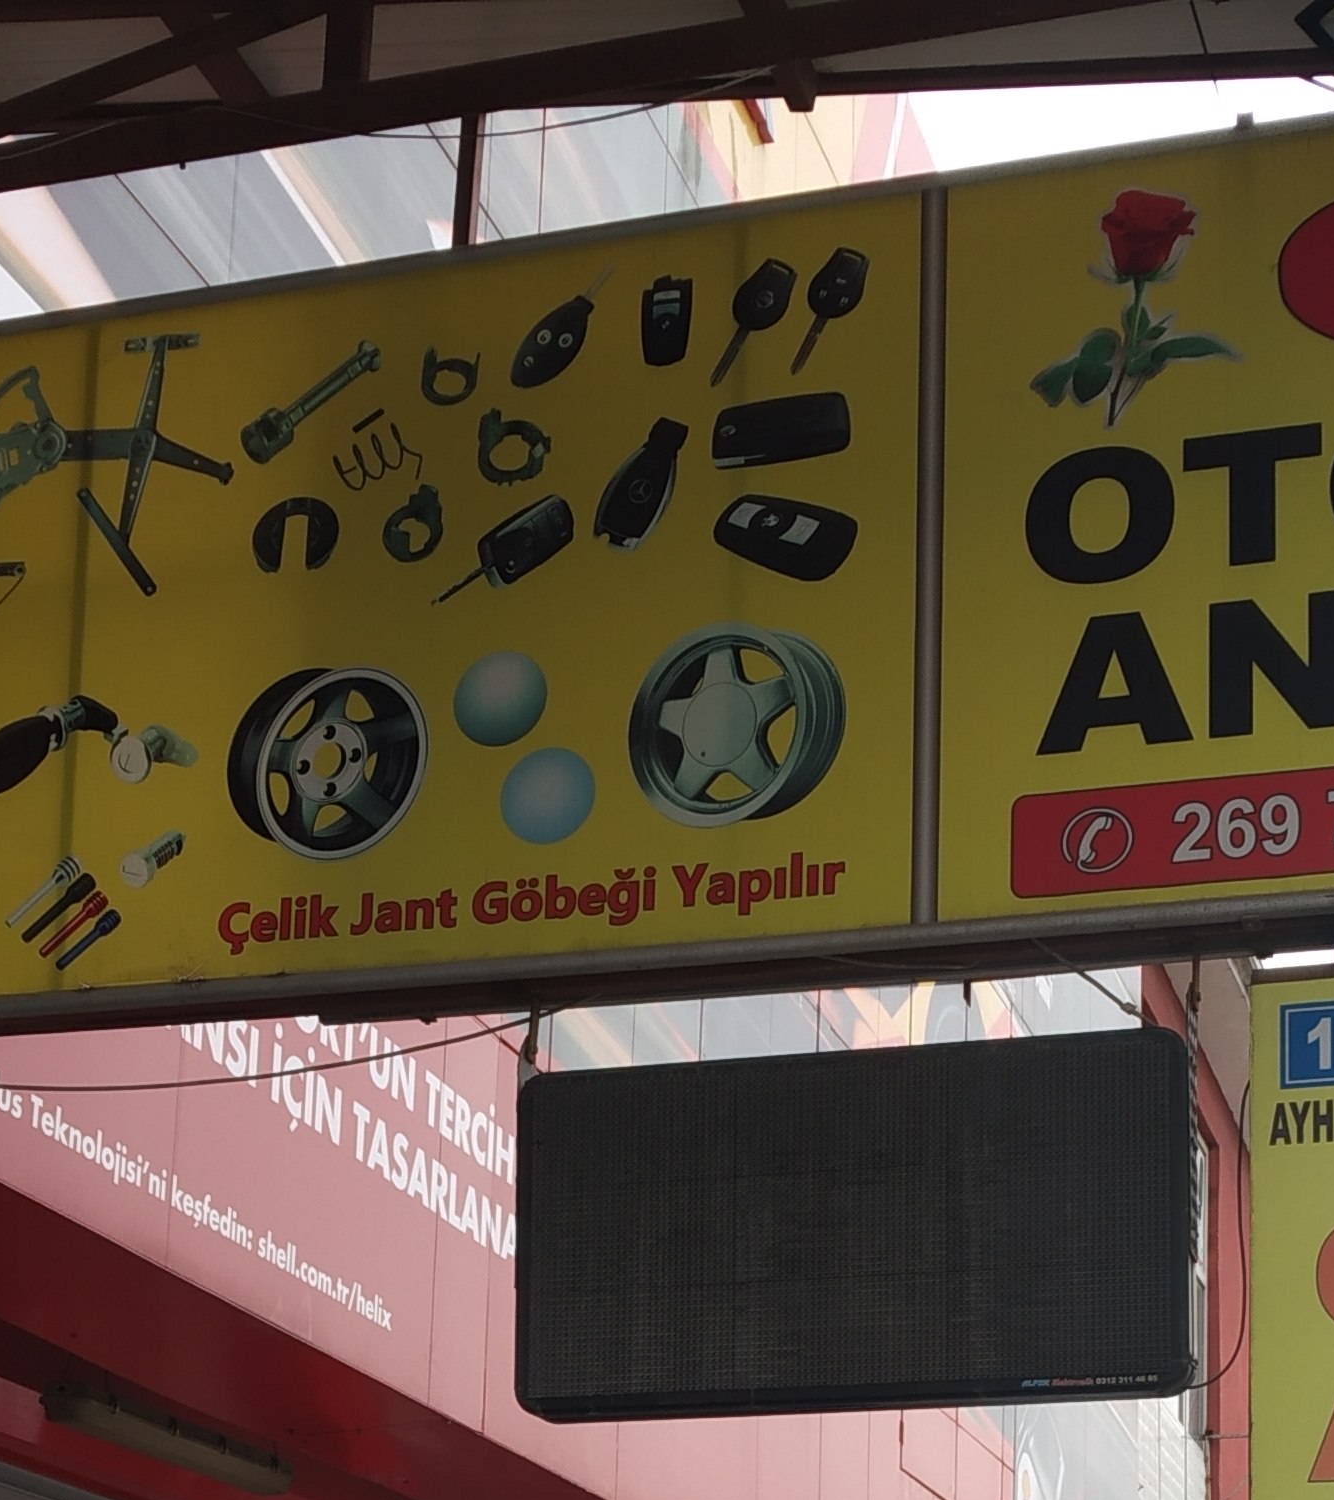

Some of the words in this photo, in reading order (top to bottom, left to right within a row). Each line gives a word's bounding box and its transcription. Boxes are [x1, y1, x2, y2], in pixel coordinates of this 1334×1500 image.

[1171, 795, 1301, 865] 269
[218, 896, 339, 955] Çelik
[350, 887, 458, 936] Jant
[472, 867, 656, 927] Göbeği
[671, 852, 846, 916] Yapılır
[271, 1023, 342, 1146] İÇİN
[354, 1100, 516, 1260] TASARLANA
[425, 1070, 515, 1185] TERCİH
[31, 1094, 167, 1201] Teknolojisi'ni
[170, 1174, 253, 1250] keşfedin:
[258, 1234, 393, 1332] shell.com.tr/helix
